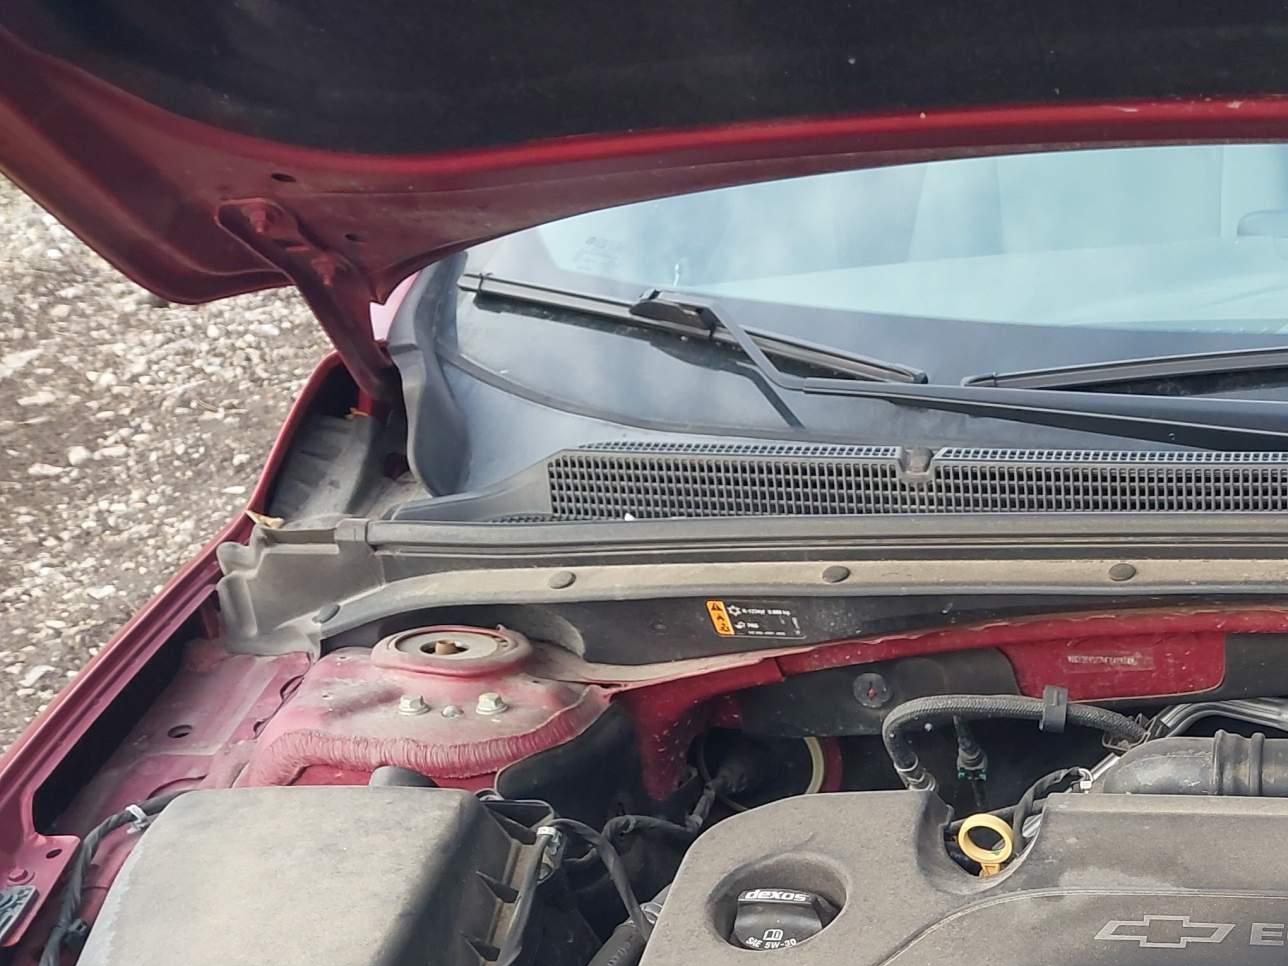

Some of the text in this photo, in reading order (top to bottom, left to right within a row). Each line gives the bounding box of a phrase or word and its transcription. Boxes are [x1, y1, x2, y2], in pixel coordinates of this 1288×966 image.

[745, 889, 810, 902] dexos
[745, 937, 797, 949] SAE 5W-30
